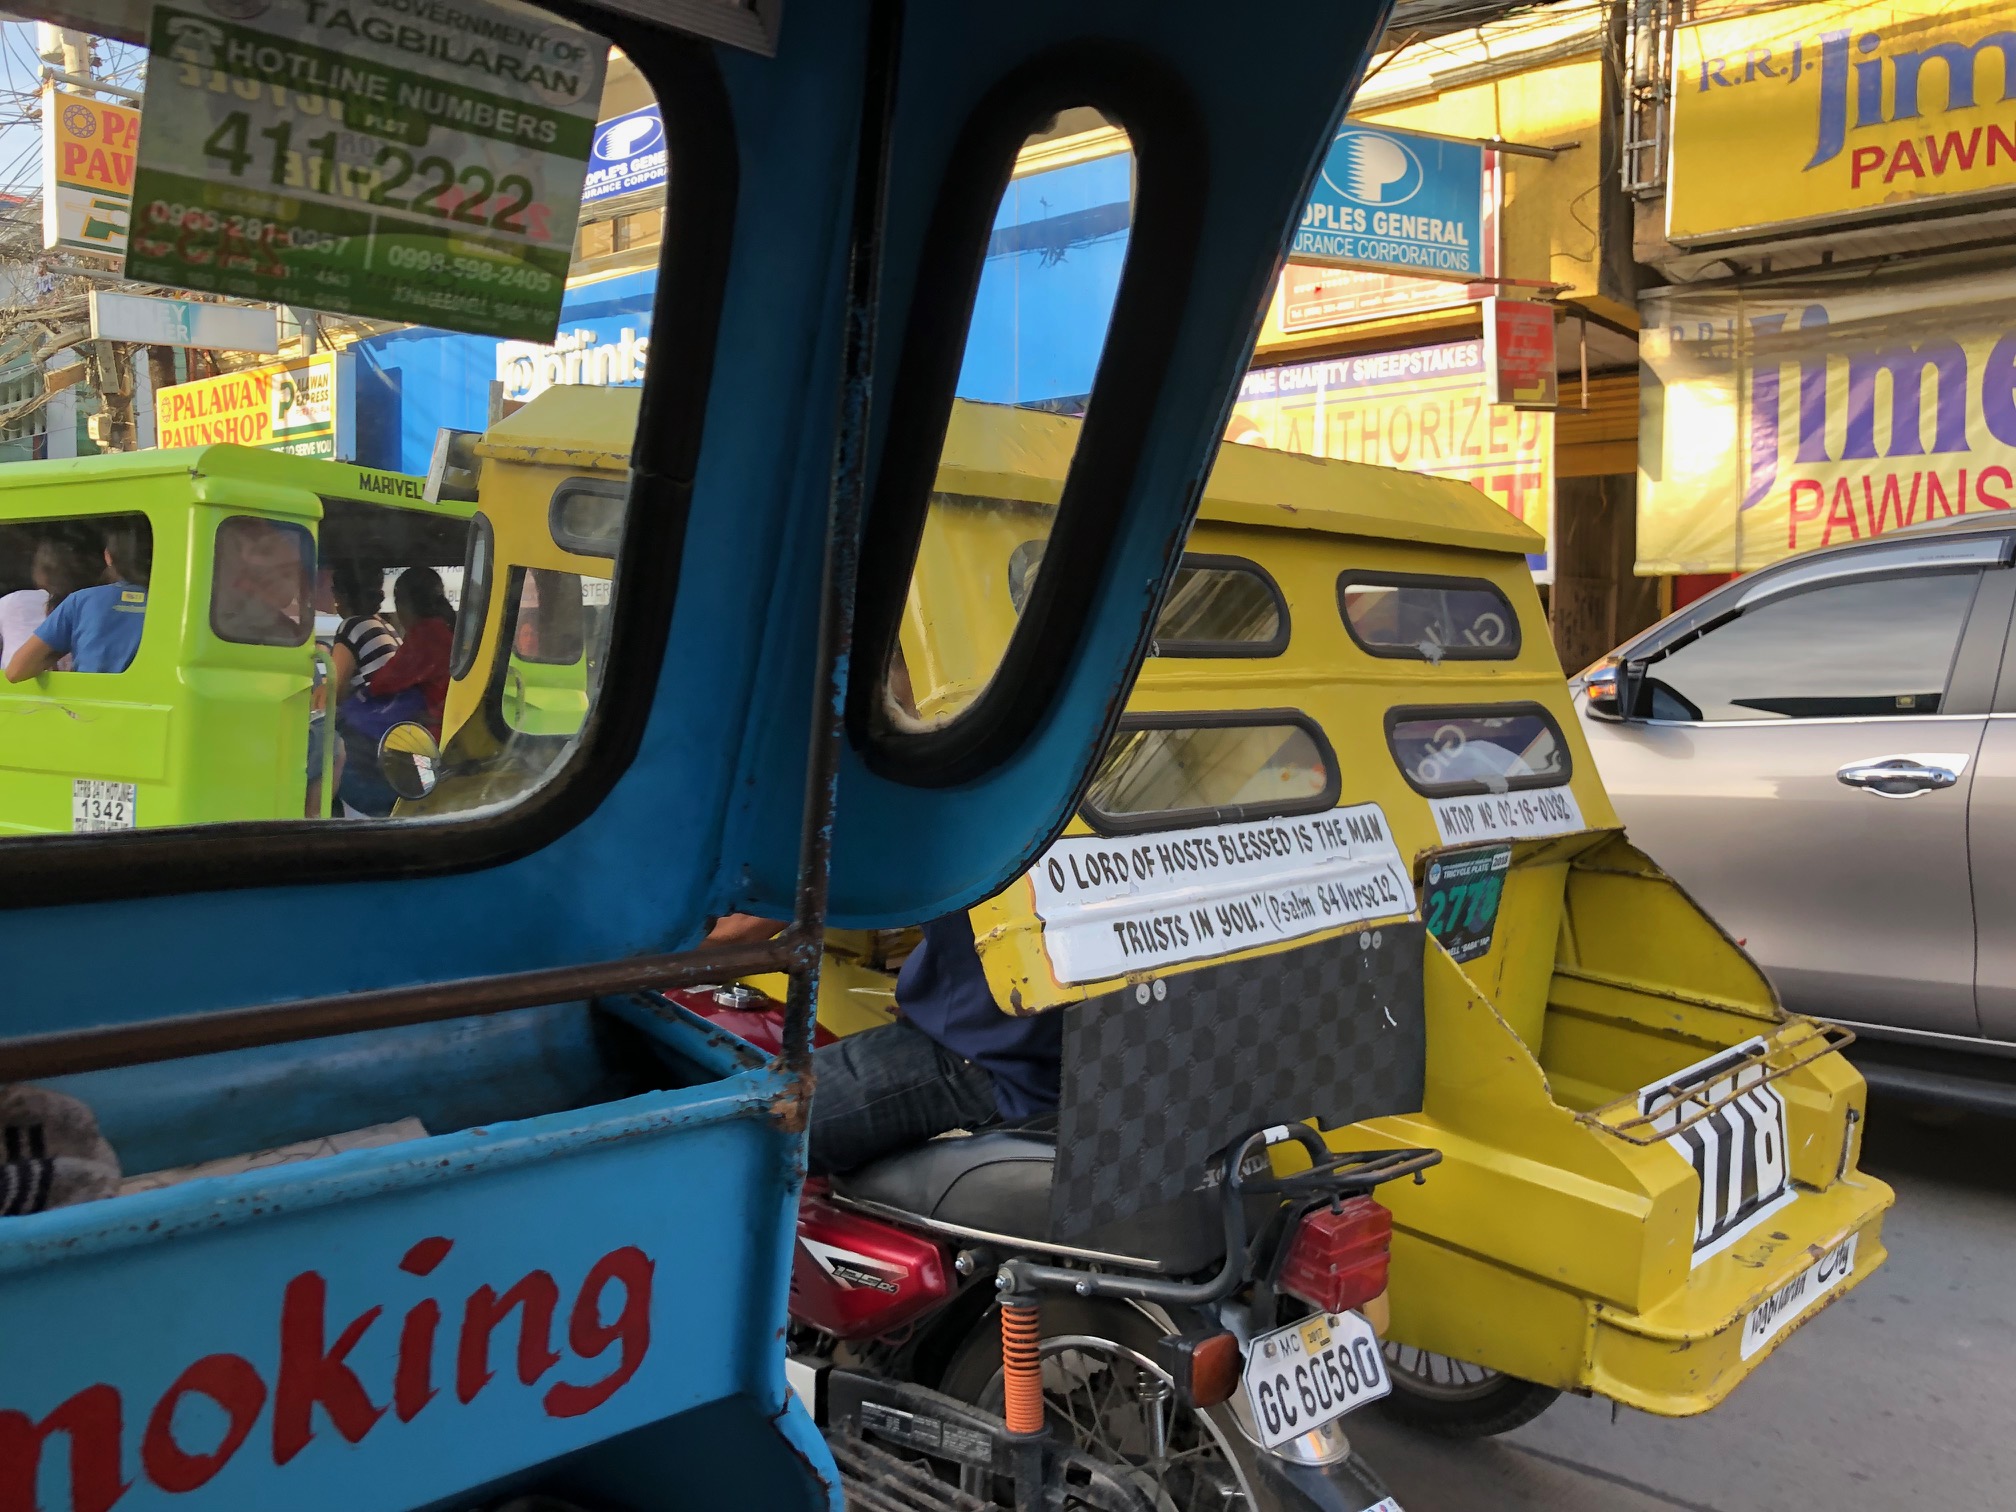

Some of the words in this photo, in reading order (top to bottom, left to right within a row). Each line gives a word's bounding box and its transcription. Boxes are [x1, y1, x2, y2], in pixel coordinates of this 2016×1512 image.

[305, 2, 579, 97] TAGBILARAN
[553, 42, 586, 61] OF
[226, 37, 391, 102] HOTLINE
[397, 81, 558, 144] NUMBERS
[203, 110, 534, 234] 411-2222
[1372, 211, 1469, 245] GENERAL
[1357, 239, 1470, 271] CORPORATIONS
[1279, 361, 1350, 391] CHARITY
[1353, 343, 1479, 382] SWEEPSTAKES
[173, 374, 269, 422] PALAWAN
[295, 389, 329, 406] EXPRESS
[162, 411, 269, 449] PAWNSHOP
[295, 441, 315, 457] SERVE
[316, 439, 332, 454] YOU
[1287, 396, 1542, 465] AUTHORIZED
[359, 472, 425, 500] MARIVEL
[81, 799, 124, 821] 1342
[1439, 803, 1476, 837] MTOP
[1498, 794, 1571, 828] 02-18-0032
[1069, 851, 1129, 890] LORD
[1132, 846, 1155, 882] OF
[1156, 837, 1219, 875] HOSTS
[1217, 826, 1292, 866] BLESSED
[1294, 823, 1314, 854] IS
[1312, 818, 1348, 851] THE
[1345, 812, 1384, 845] MAN
[1443, 867, 1472, 880] TRICYCLE
[1471, 863, 1491, 876] PLATE
[1113, 912, 1189, 958] TRUSTS
[1190, 908, 1210, 941] IN
[1262, 890, 1314, 934] (Psalm
[1339, 877, 1380, 916] Verse
[1278, 1333, 1301, 1359] MC
